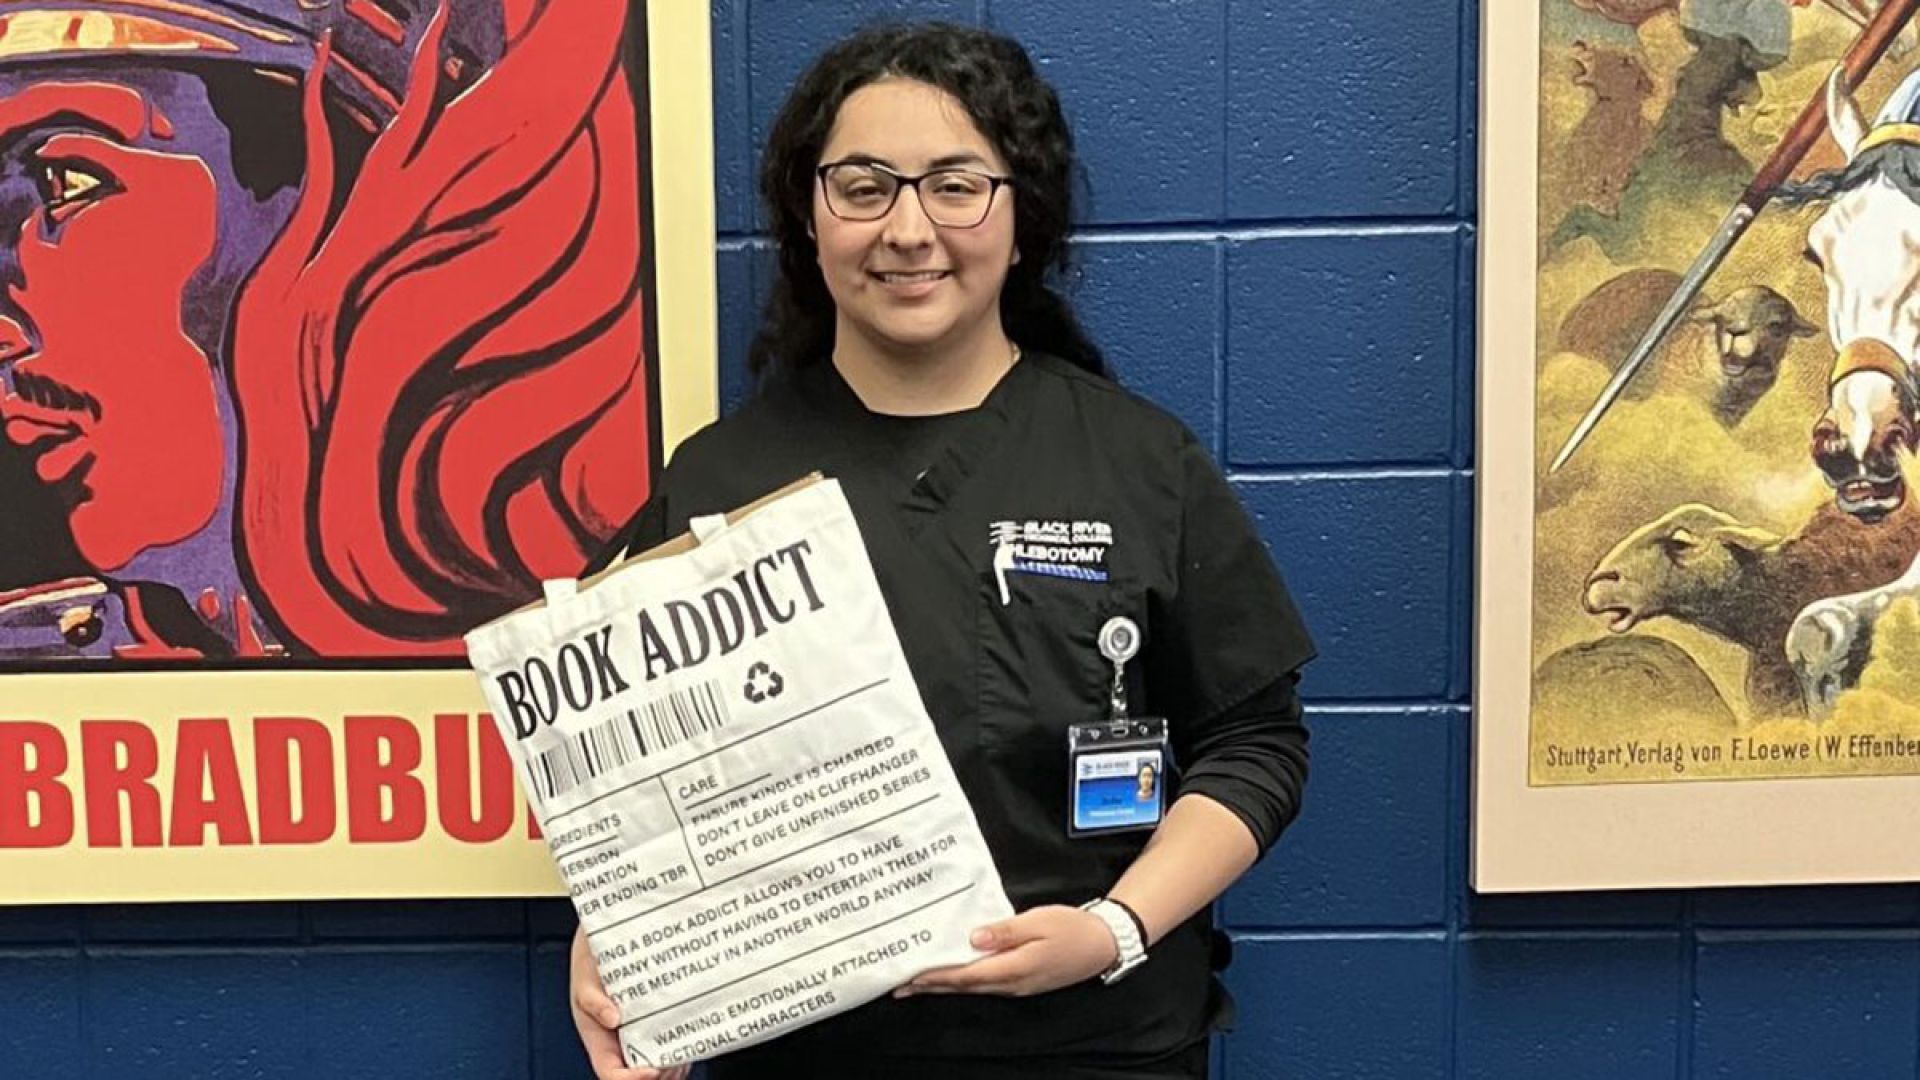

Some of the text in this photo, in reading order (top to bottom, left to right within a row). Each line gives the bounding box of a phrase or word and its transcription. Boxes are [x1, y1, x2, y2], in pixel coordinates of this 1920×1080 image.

[1012, 544, 1104, 563] HLEBOTOMY
[496, 539, 825, 741] BOOK ADDICT
[0, 714, 546, 849] BRADBU
[679, 775, 719, 800] CARE
[691, 735, 895, 826] ENSURE KINDLE IS CHARGED
[697, 749, 920, 847] DON'T LEAVE ON CLIFFHANGER
[1690, 744, 1721, 762] von
[704, 767, 931, 867] DON'T GIVE UNFINISHED SERIES
[602, 876, 658, 907] ENDING
[659, 863, 688, 885] TBR
[629, 939, 641, 953] A
[641, 922, 685, 947] BOOK
[687, 898, 740, 929] ADDICT
[743, 874, 803, 907] ALLOWS
[803, 860, 836, 881] YOU
[837, 852, 859, 869] TO
[861, 835, 904, 861] HAVE
[647, 951, 722, 991] MENTALLY
[724, 946, 741, 961] IN
[743, 917, 813, 953] ANOTHER
[815, 894, 870, 925] WORLD
[873, 868, 934, 902] ANYWAY
[651, 930, 720, 966] WITHOUT
[722, 906, 779, 938] HAVING
[780, 895, 801, 912] TO
[802, 865, 884, 905] ENTERTAIN
[885, 847, 930, 874] THEM
[930, 834, 958, 856] FOR
[653, 929, 932, 1046] WARNING: EMOTIONALLY ATTACHED TO
[659, 990, 837, 1067] FICTIONAL CHARACTERS
